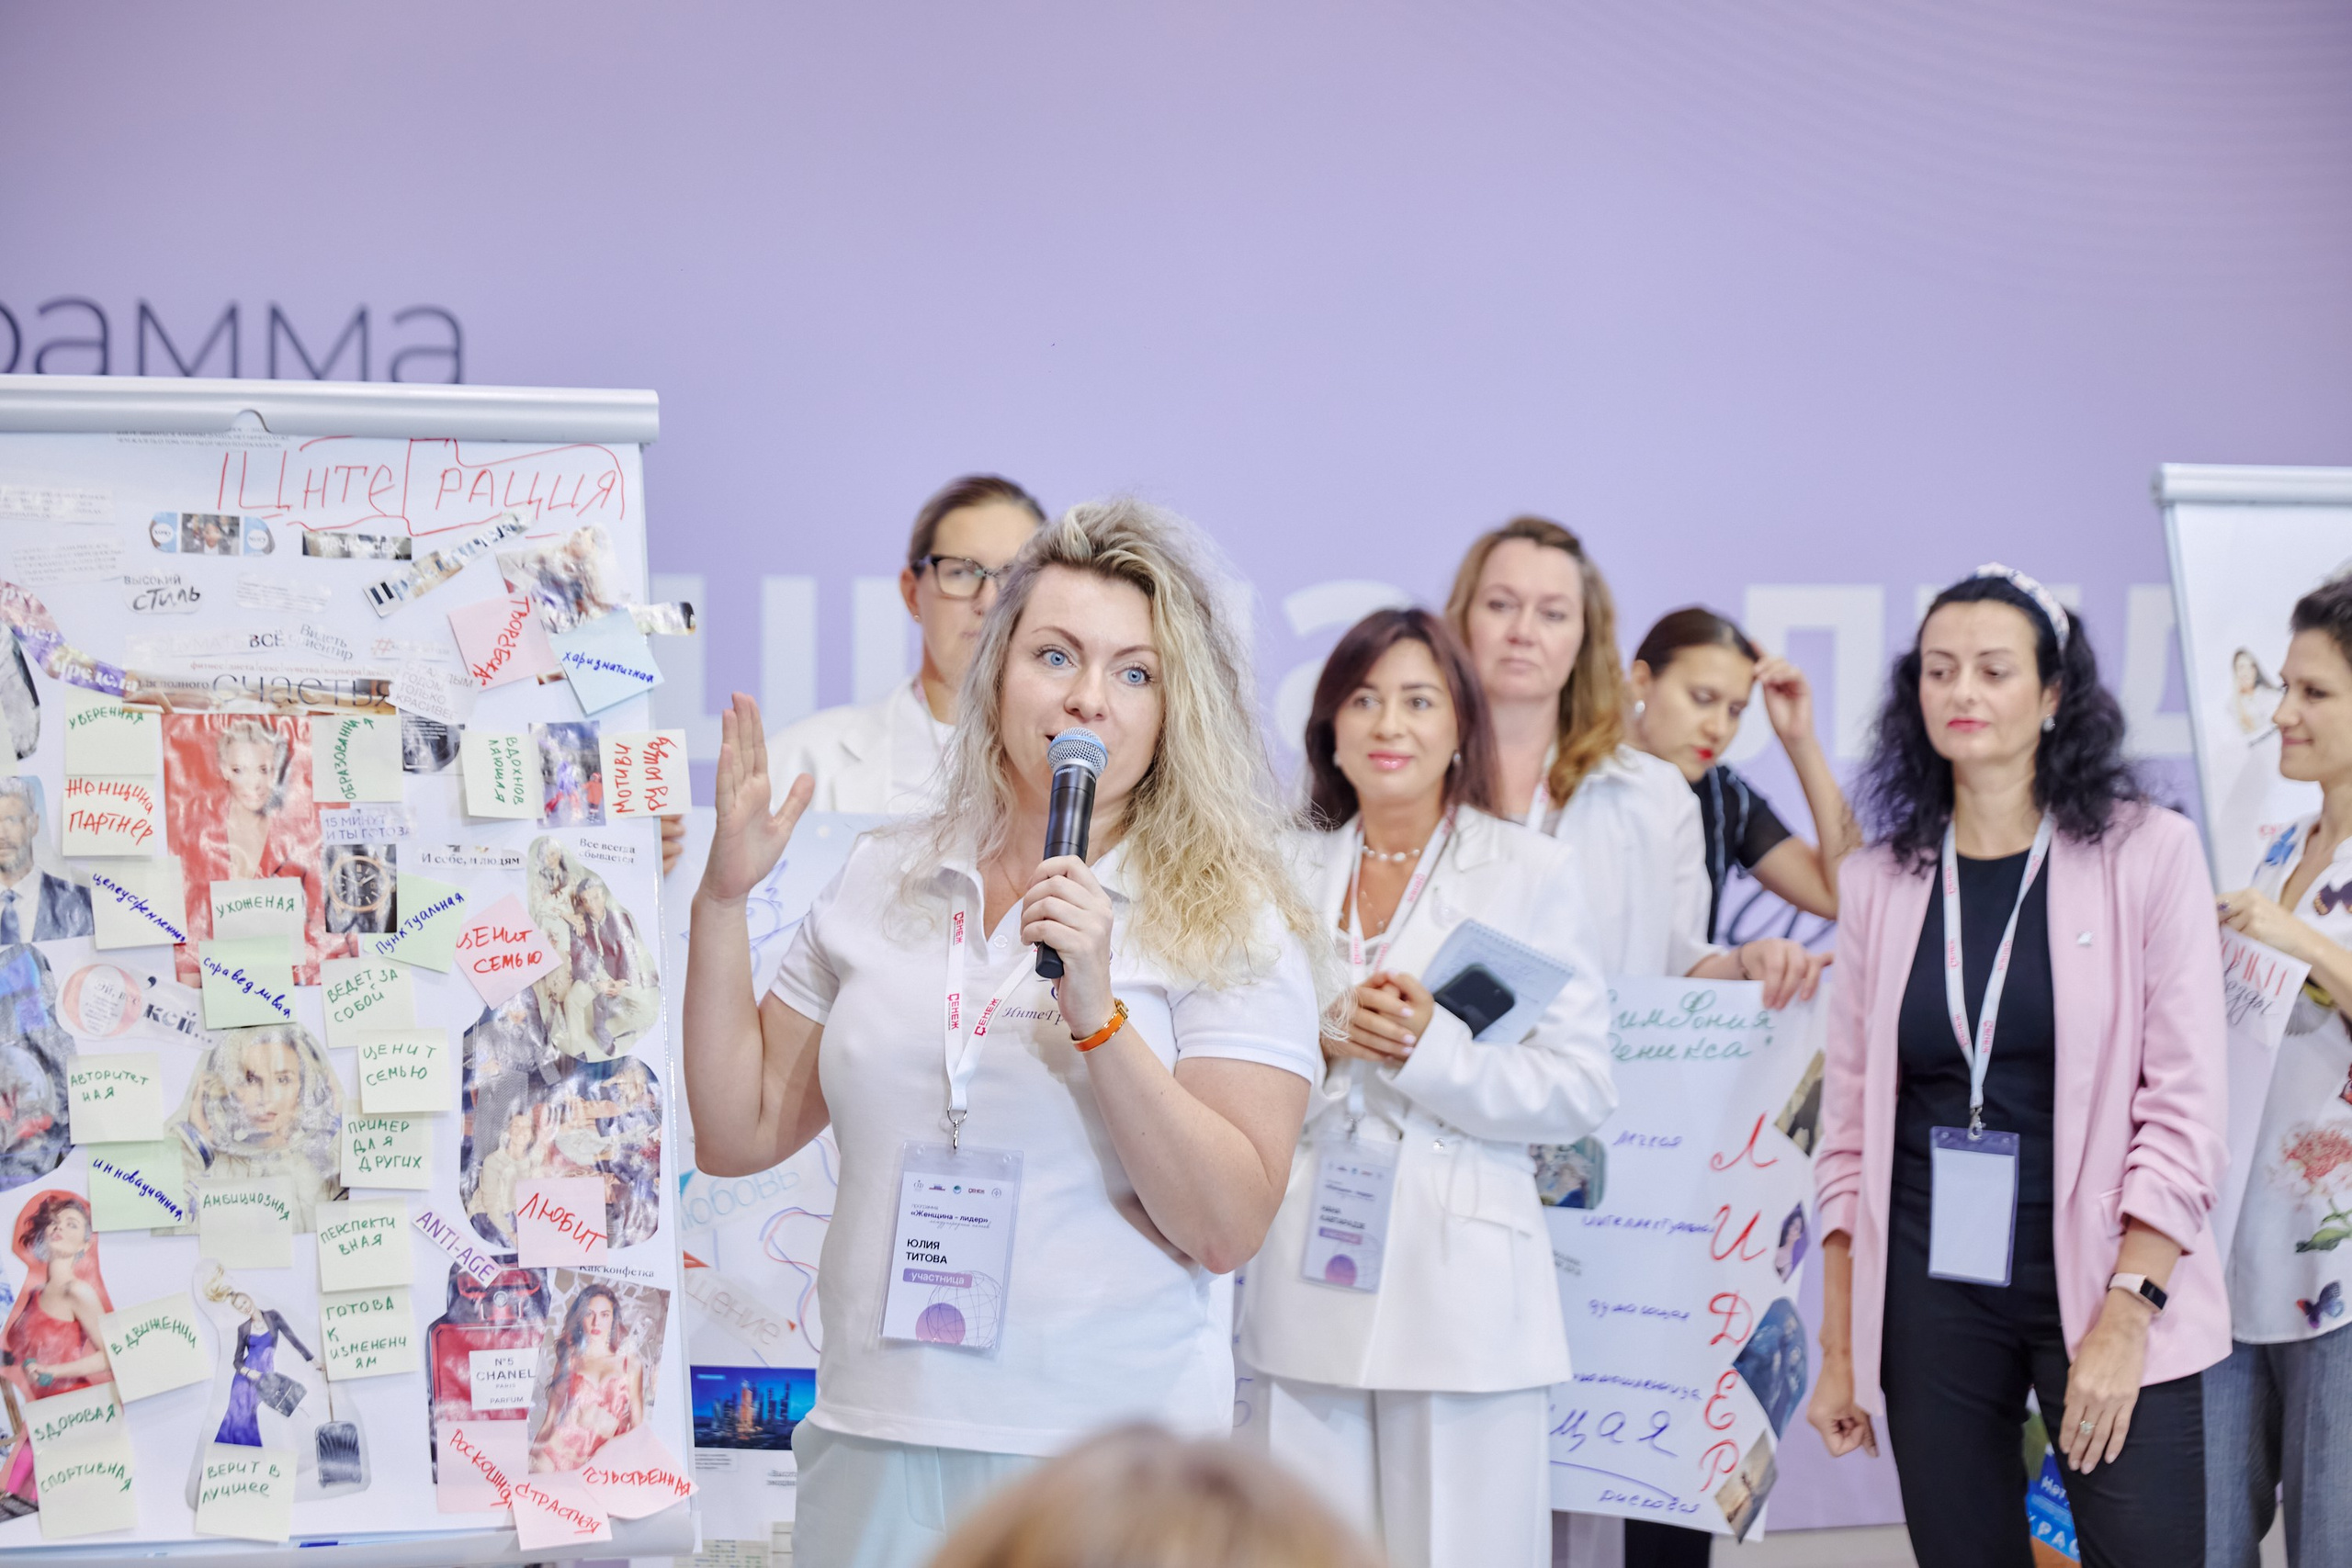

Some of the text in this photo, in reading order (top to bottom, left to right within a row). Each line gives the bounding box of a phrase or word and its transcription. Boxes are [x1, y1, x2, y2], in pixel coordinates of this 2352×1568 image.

[579, 838, 598, 850] Все
[416, 1210, 496, 1282] ANTI-AGE
[907, 1238, 940, 1250] ЮЛИЯ
[906, 1251, 948, 1265] ТИТОВА
[910, 1271, 966, 1285] участница
[476, 1368, 537, 1382] CHANEL
[490, 1395, 525, 1404] PARFUM
